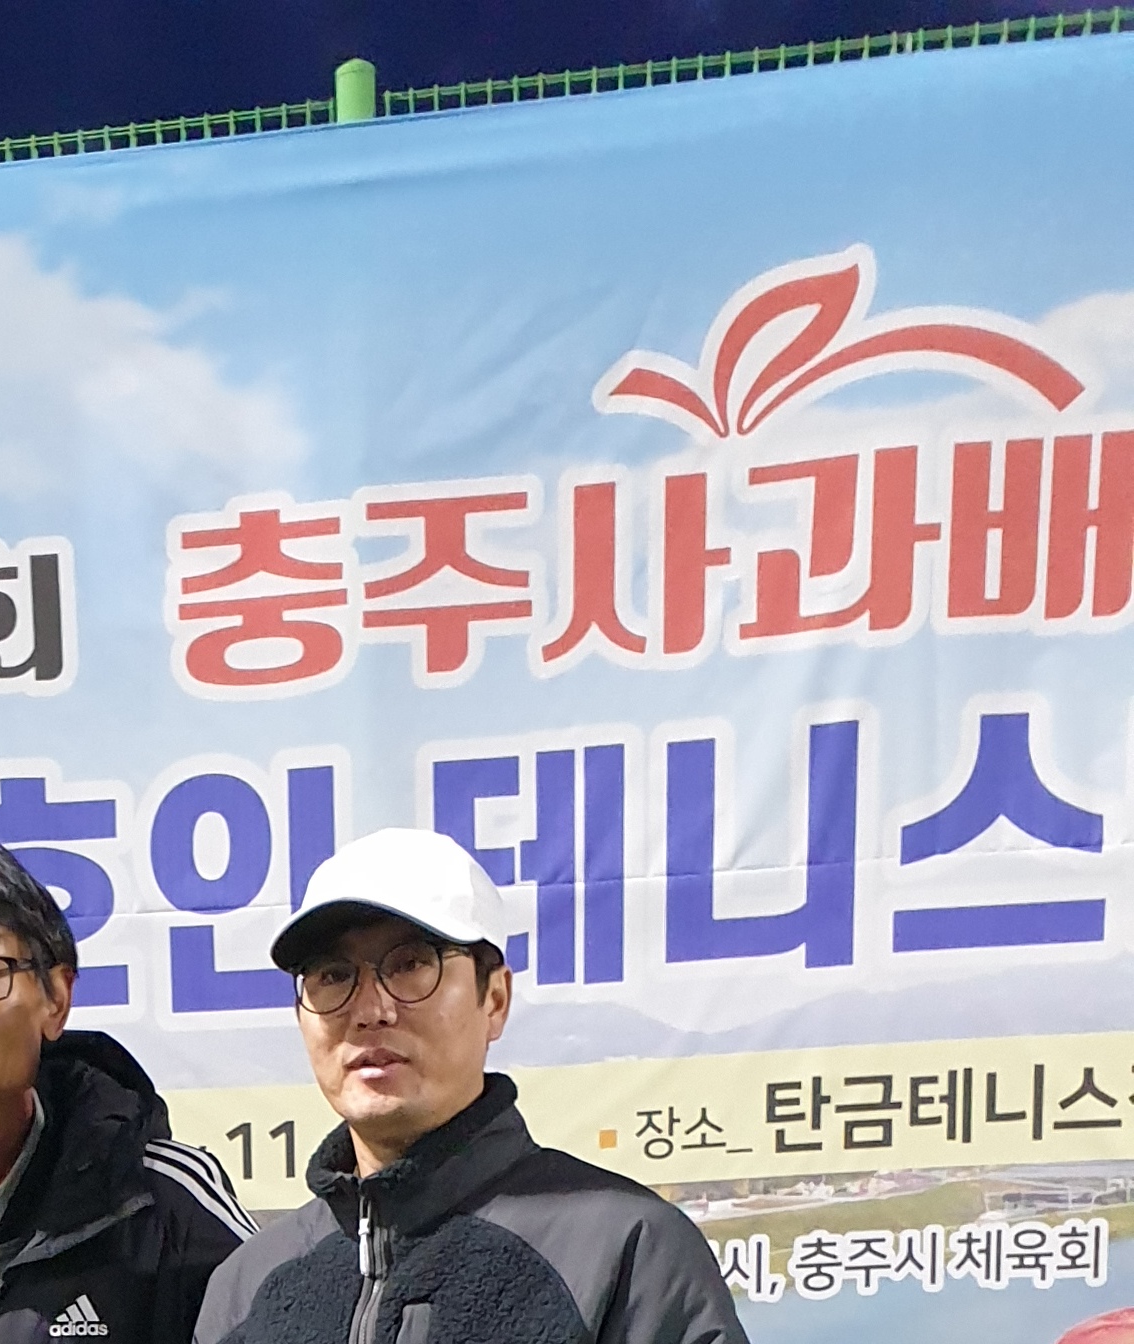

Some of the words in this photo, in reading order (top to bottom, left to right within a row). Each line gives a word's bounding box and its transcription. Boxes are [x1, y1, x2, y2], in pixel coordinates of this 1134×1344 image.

[177, 430, 1134, 687] 충주사과배
[432, 712, 1106, 985] 테니스
[766, 1063, 1134, 1153] 탄금테니스
[795, 1231, 937, 1292] 충주시
[955, 1224, 1102, 1283] 체육회
[49, 1320, 108, 1337] adidas
